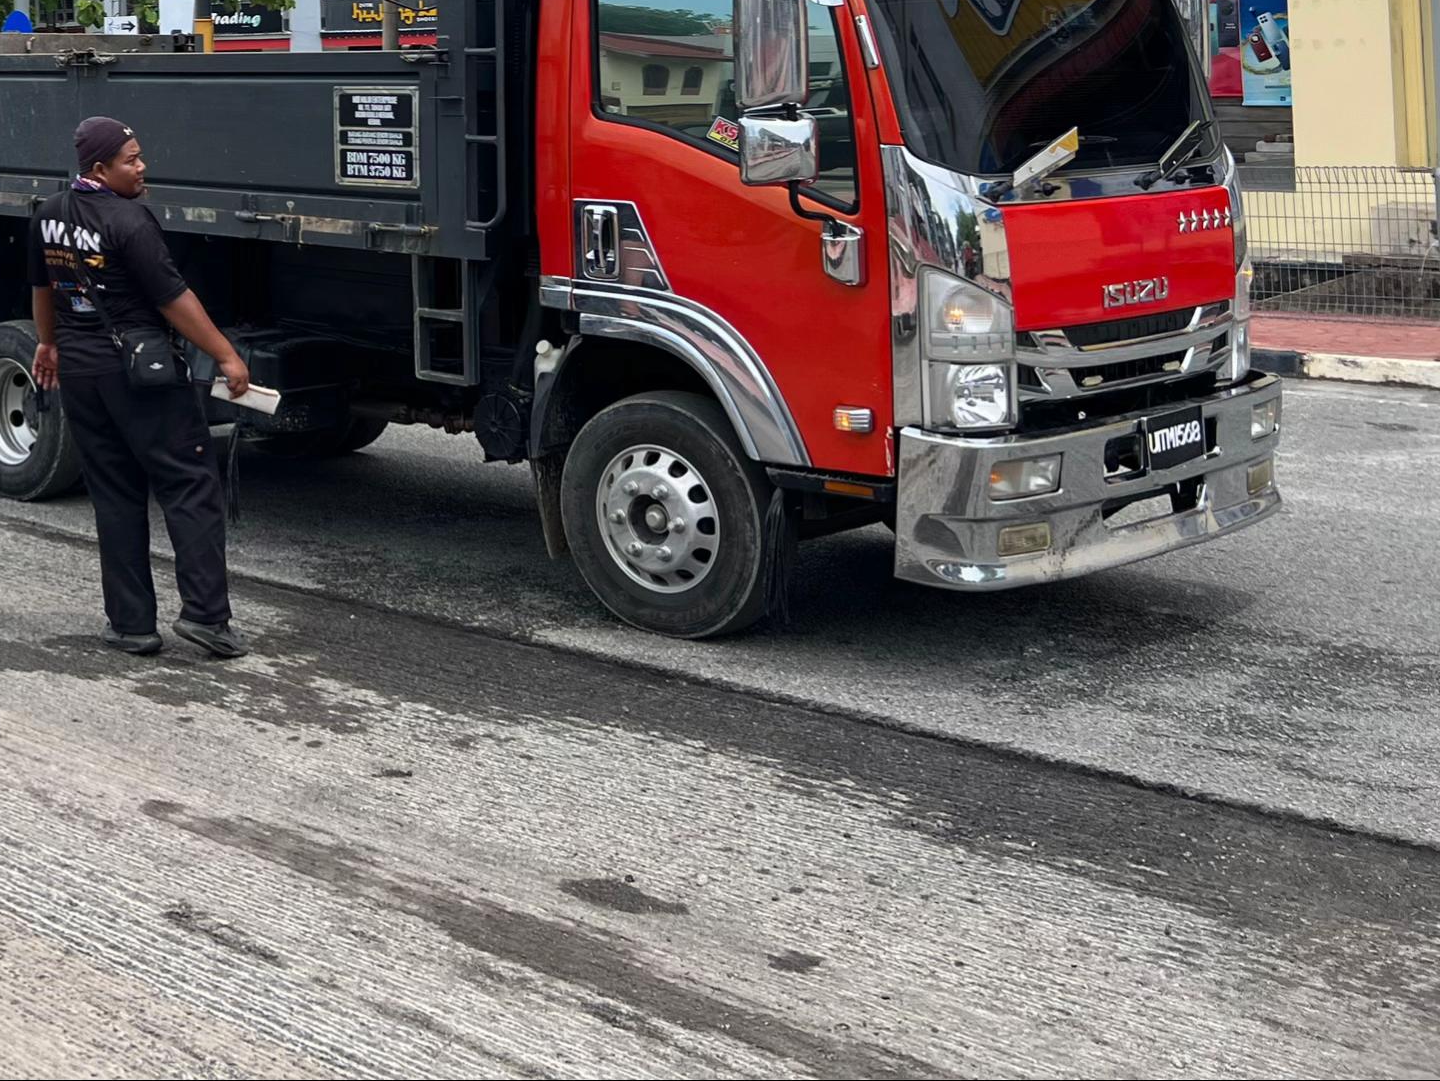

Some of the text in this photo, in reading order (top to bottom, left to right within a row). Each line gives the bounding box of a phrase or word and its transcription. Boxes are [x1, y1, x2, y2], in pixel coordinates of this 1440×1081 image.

[211, 12, 262, 27] Trading
[346, 151, 406, 165] BDM 7500 KG
[346, 164, 407, 178] BTM 3750 KG
[1102, 277, 1168, 308] ISUZU
